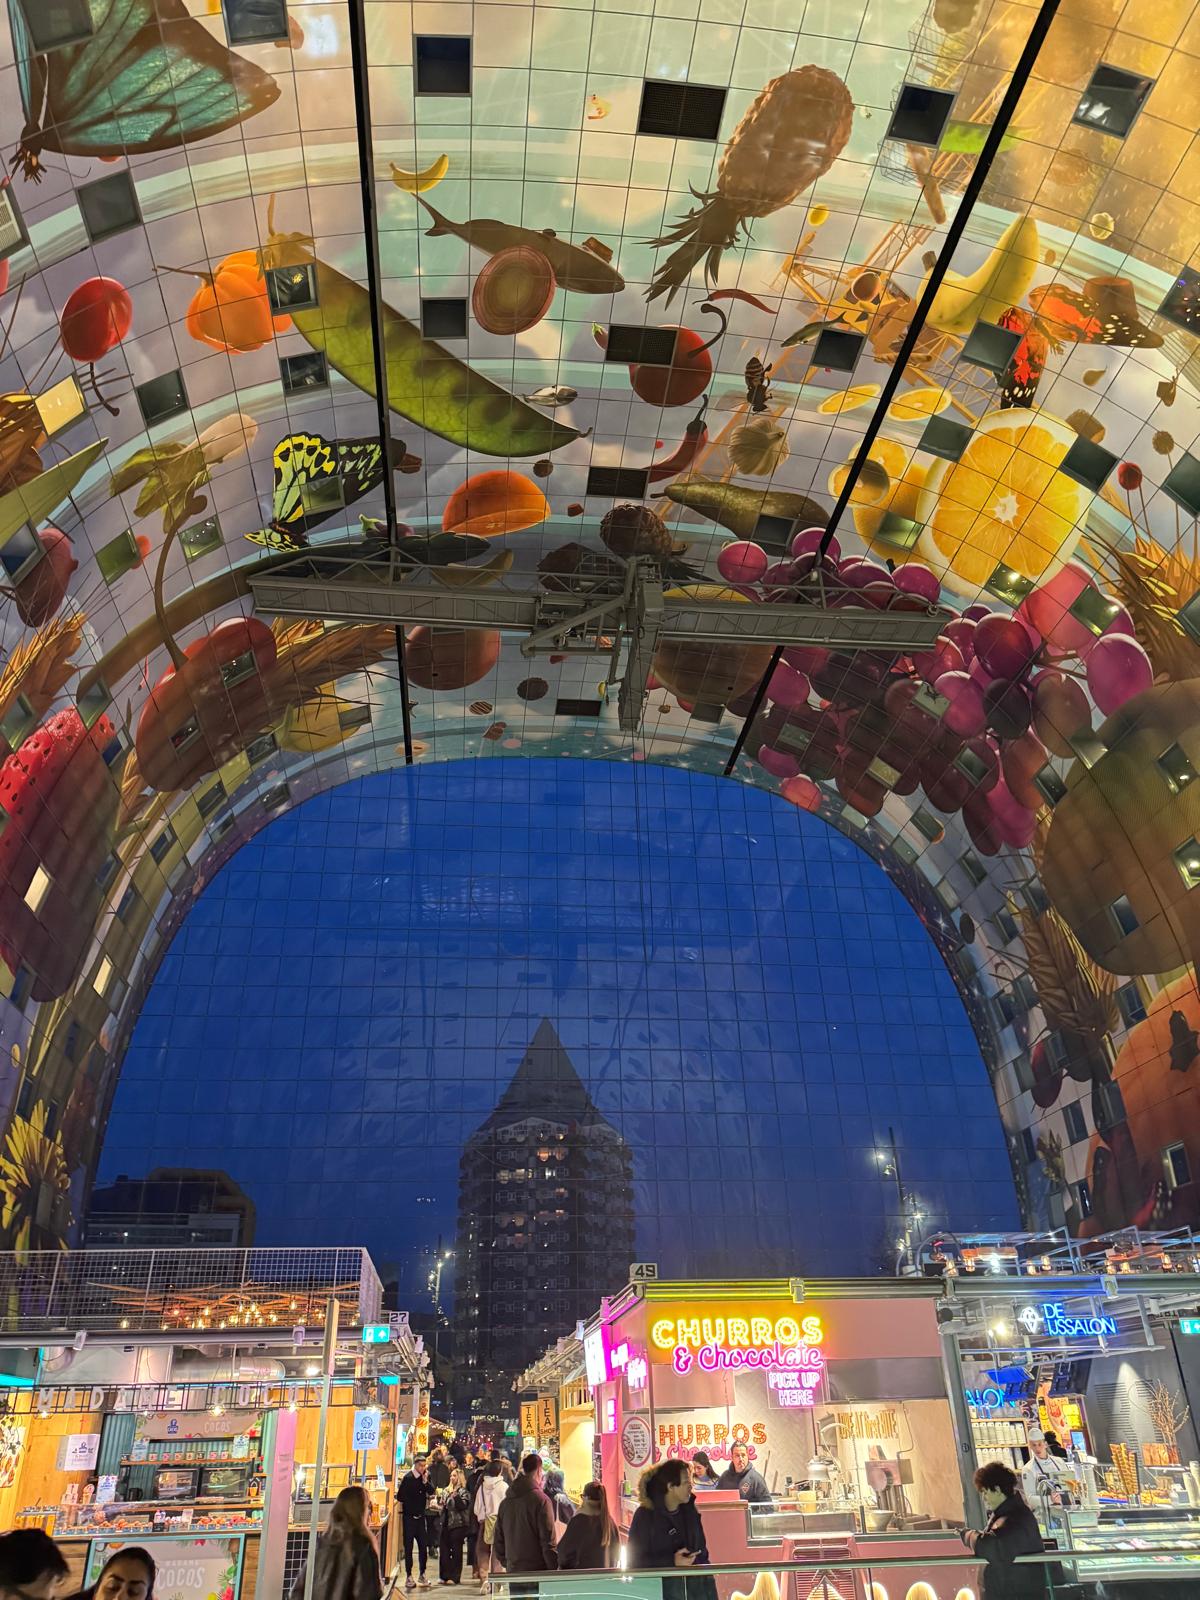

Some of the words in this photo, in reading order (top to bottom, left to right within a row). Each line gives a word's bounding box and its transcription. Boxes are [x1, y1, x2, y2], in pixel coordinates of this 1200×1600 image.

[635, 1264, 656, 1278] 49
[390, 1312, 407, 1322] 27
[1043, 1302, 1064, 1319] DE
[652, 1316, 823, 1348] CHURROS
[1047, 1317, 1117, 1335] IJSSALON
[674, 1345, 692, 1375] &
[698, 1341, 824, 1370] Chocolate
[769, 1372, 800, 1389] PICK
[801, 1371, 820, 1388] UP
[37, 1384, 178, 1411] MADAME
[213, 1382, 322, 1406] COCOS
[779, 1390, 814, 1406] HERE
[543, 1400, 552, 1426] TEA
[356, 1431, 376, 1441] COCOS
[156, 1567, 205, 1590] COCOS
